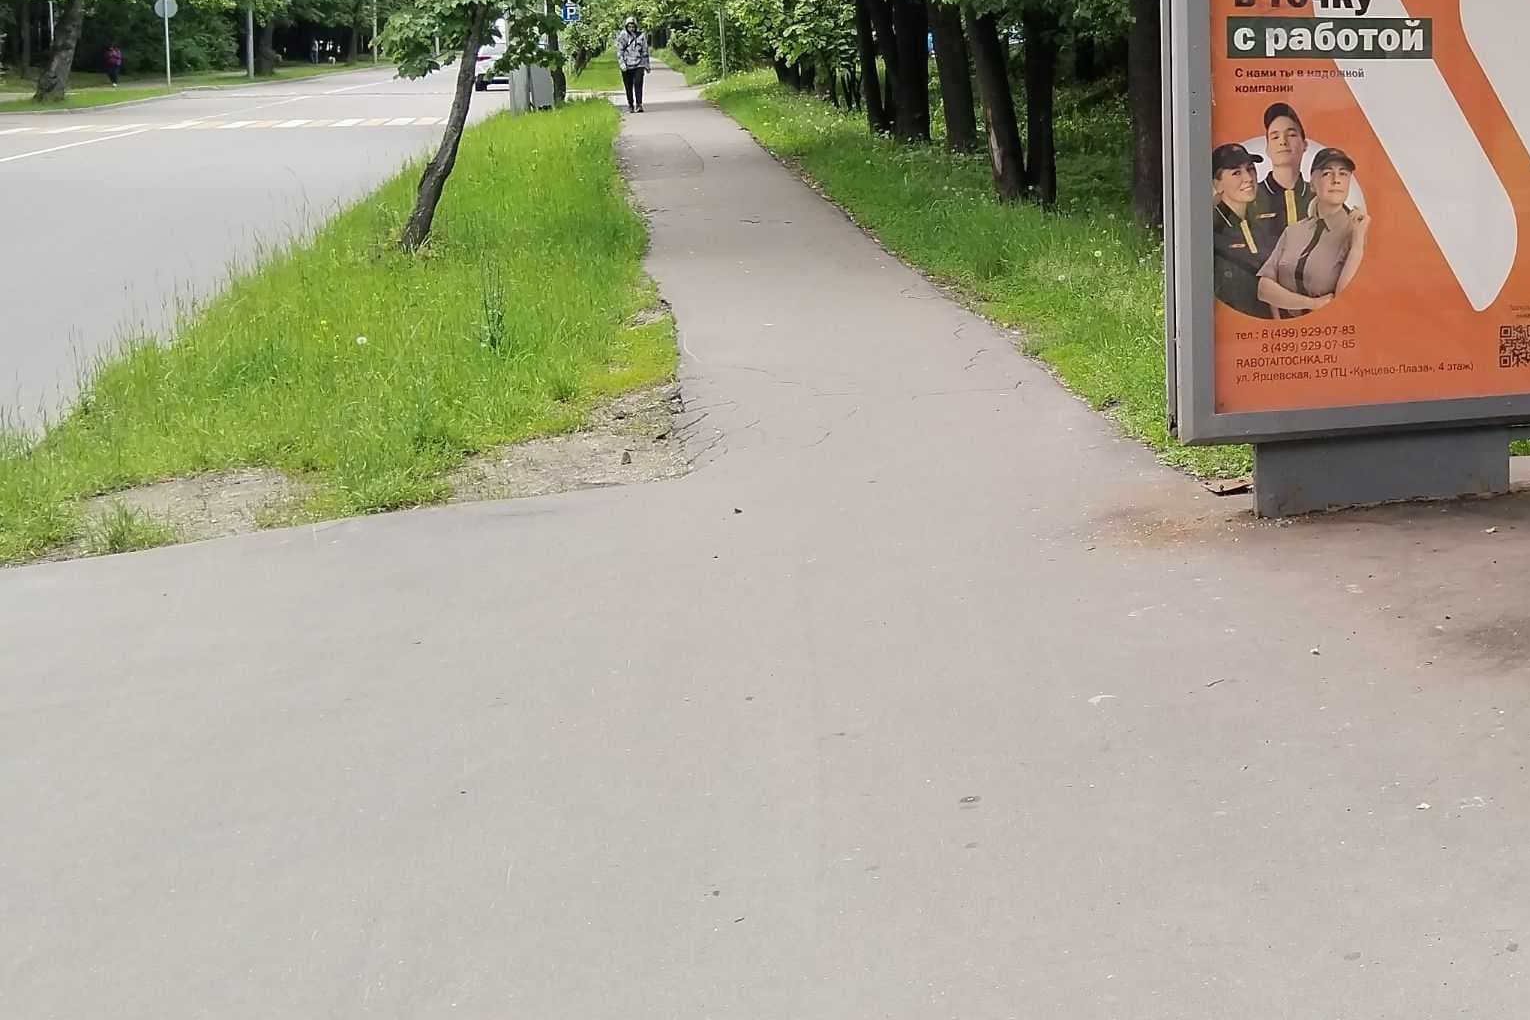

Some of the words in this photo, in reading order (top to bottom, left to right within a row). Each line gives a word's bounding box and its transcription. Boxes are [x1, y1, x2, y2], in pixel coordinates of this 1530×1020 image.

[1233, 26, 1256, 51] с
[1265, 19, 1425, 57] работой
[1235, 68, 1244, 78] С
[1246, 69, 1277, 78] нами
[1280, 69, 1294, 78] ты
[1235, 84, 1294, 94] компании
[1261, 329, 1268, 339] 8
[1271, 328, 1299, 339] (499)
[1300, 325, 1356, 337] 929-07-83
[1261, 343, 1268, 353] 8
[1271, 342, 1299, 354] (499)
[1236, 354, 1338, 369] RABOTAITOCHKA.RU
[1236, 373, 1250, 384] ул.
[1252, 371, 1312, 383] Ярцевская,
[1315, 368, 1328, 379] 19
[1330, 367, 1347, 379] (ТЦ
[1438, 362, 1445, 372] 4
[1447, 361, 1474, 372] этаж)
